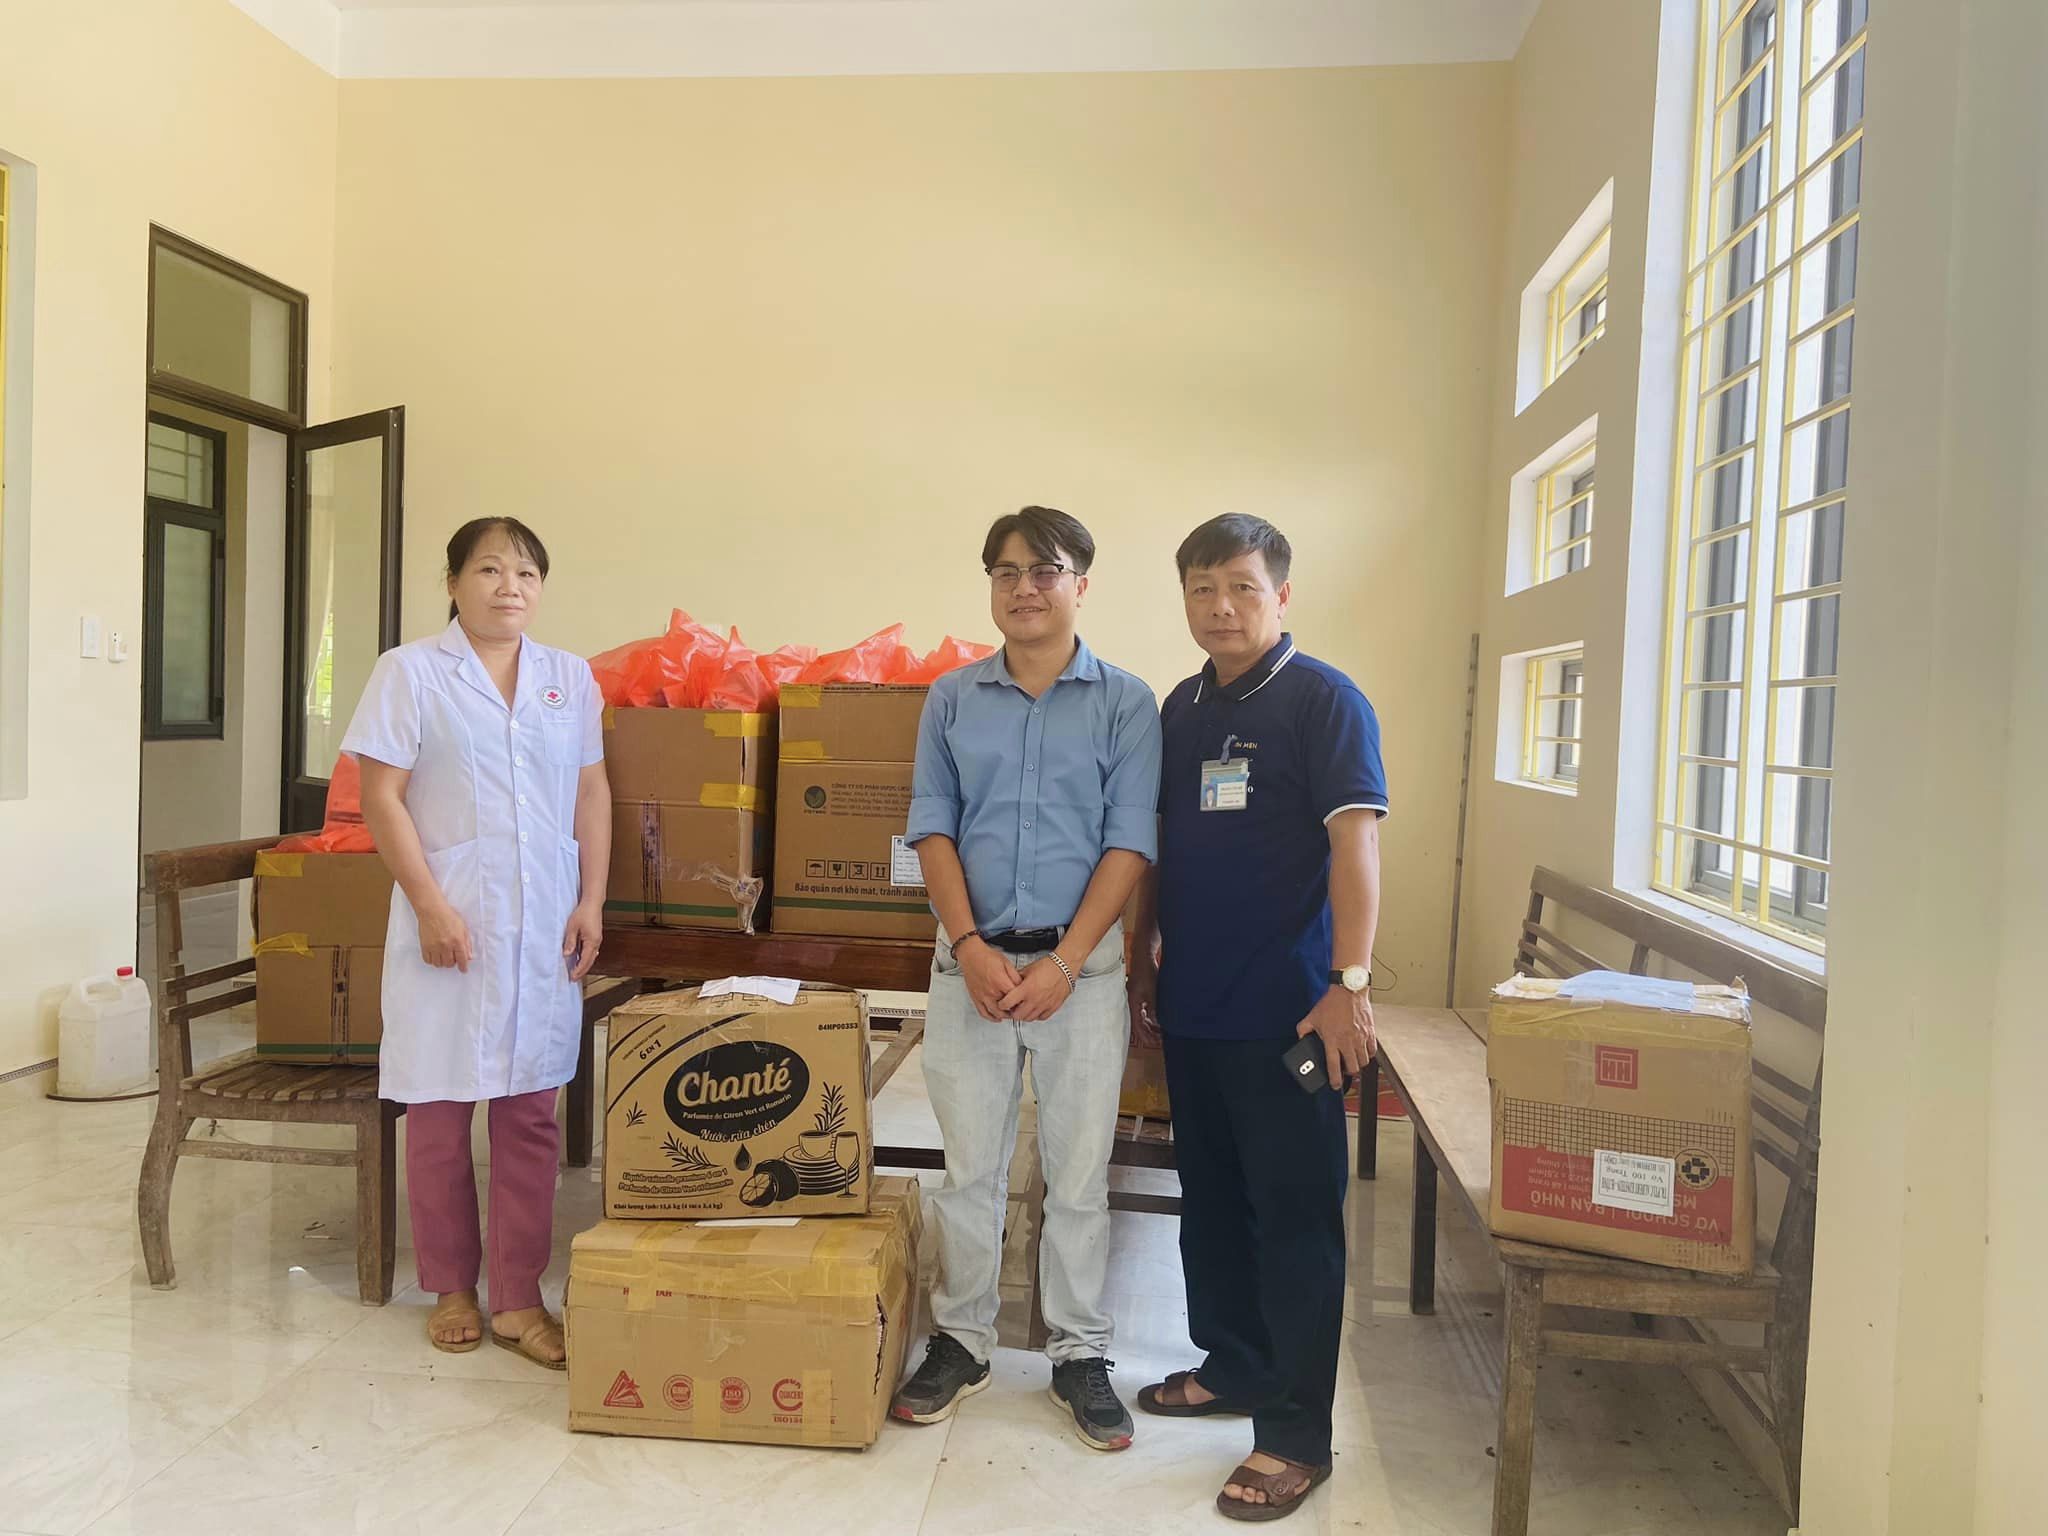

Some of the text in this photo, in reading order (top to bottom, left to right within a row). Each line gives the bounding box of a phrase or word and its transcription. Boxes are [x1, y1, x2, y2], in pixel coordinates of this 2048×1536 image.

[677, 1057, 792, 1107] Chanté
[744, 1106, 758, 1116] Vert
[753, 1118, 779, 1136] chén
